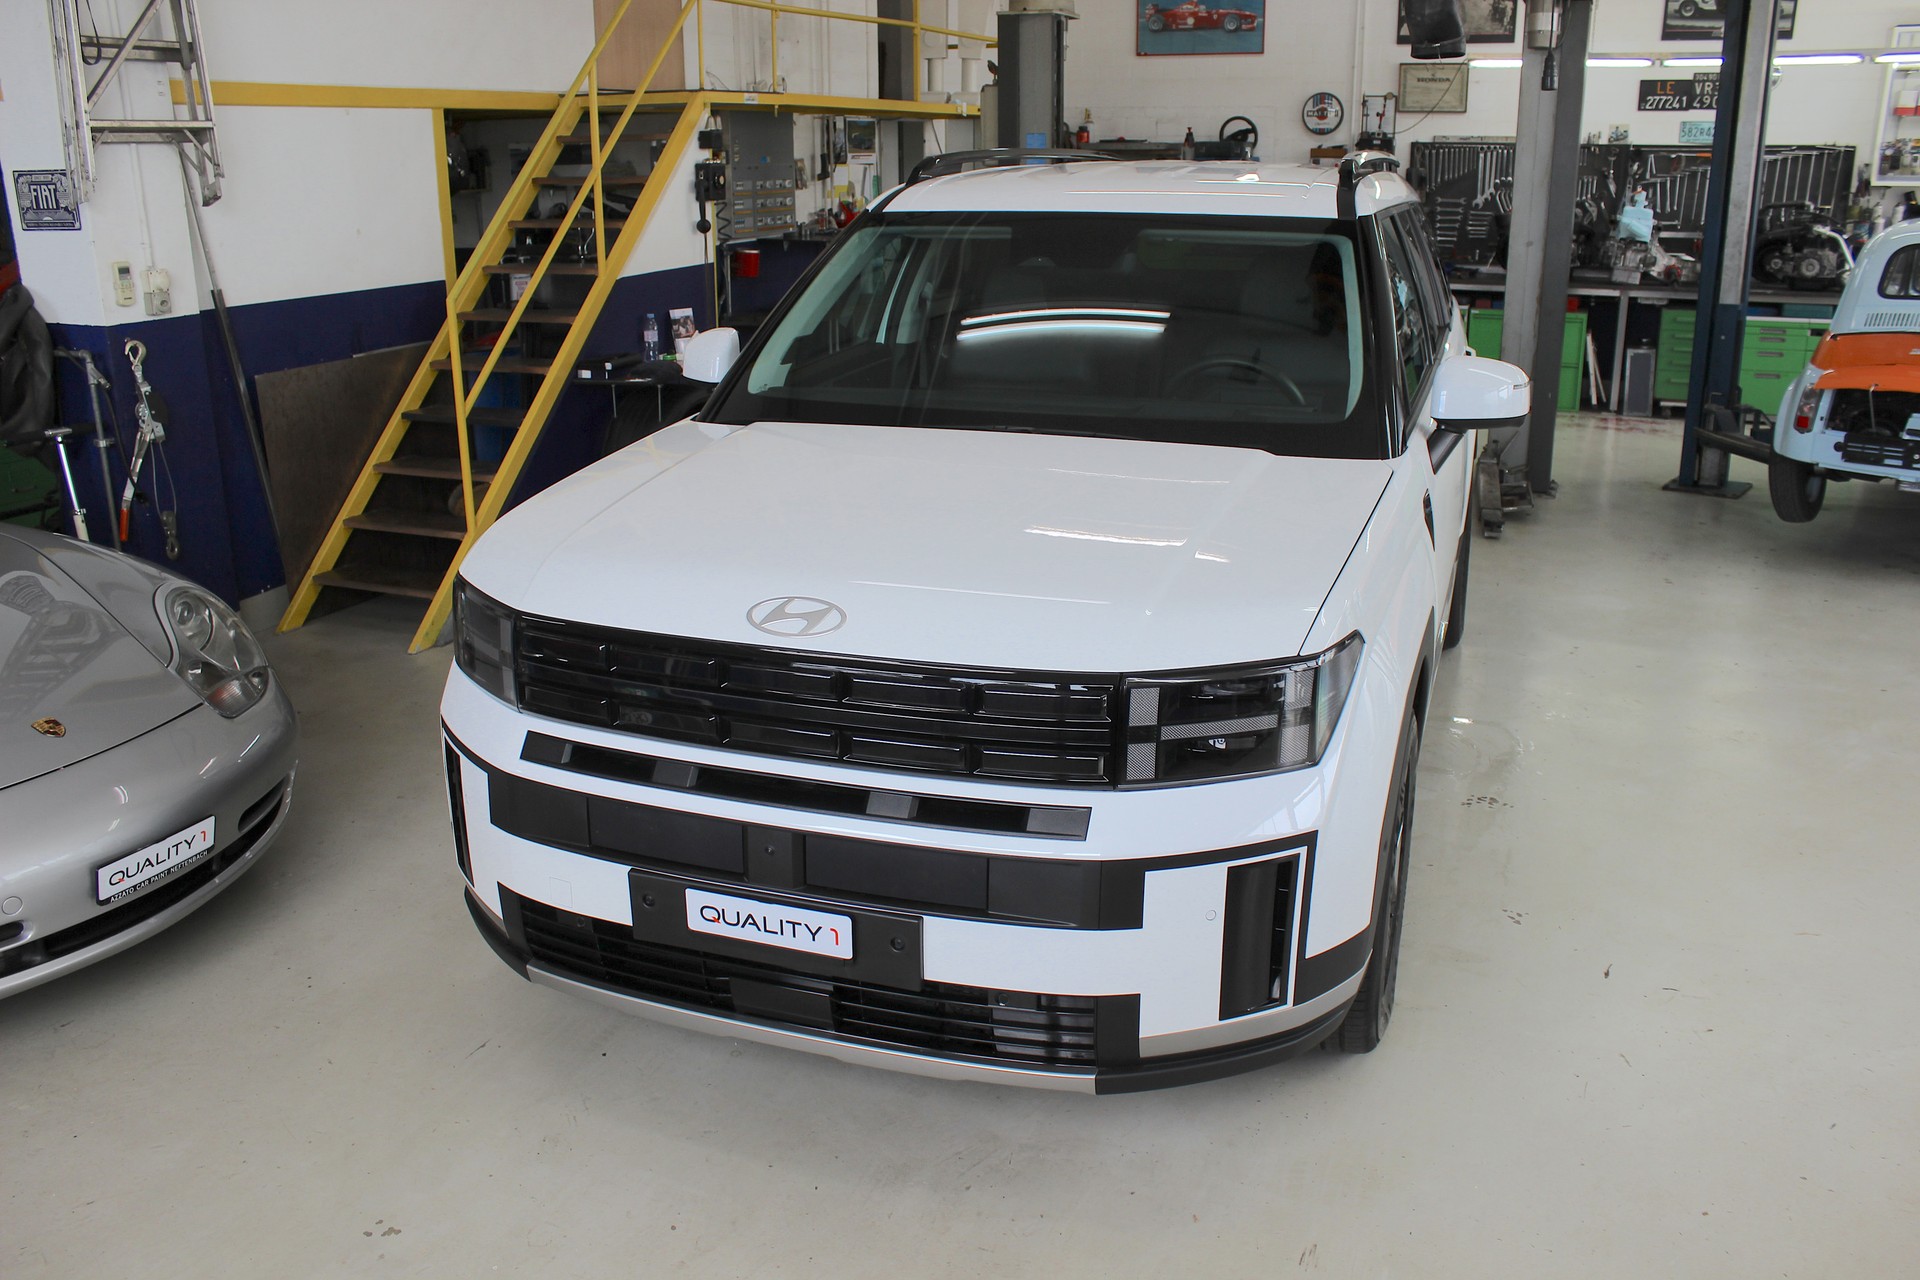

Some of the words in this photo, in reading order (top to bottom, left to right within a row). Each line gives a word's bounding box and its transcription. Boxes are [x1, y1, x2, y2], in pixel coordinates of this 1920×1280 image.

[1646, 95, 1687, 109] 277241
[1657, 81, 1675, 94] LE
[31, 185, 57, 209] FIAT
[109, 834, 196, 886] QUALITY
[200, 830, 207, 842] 1
[110, 888, 134, 903] AZZATO
[136, 880, 149, 891] CAR
[150, 870, 168, 883] PAINT
[170, 850, 208, 873] NEFTENBACH
[700, 905, 822, 942] QUALITY
[829, 927, 839, 946] 1
